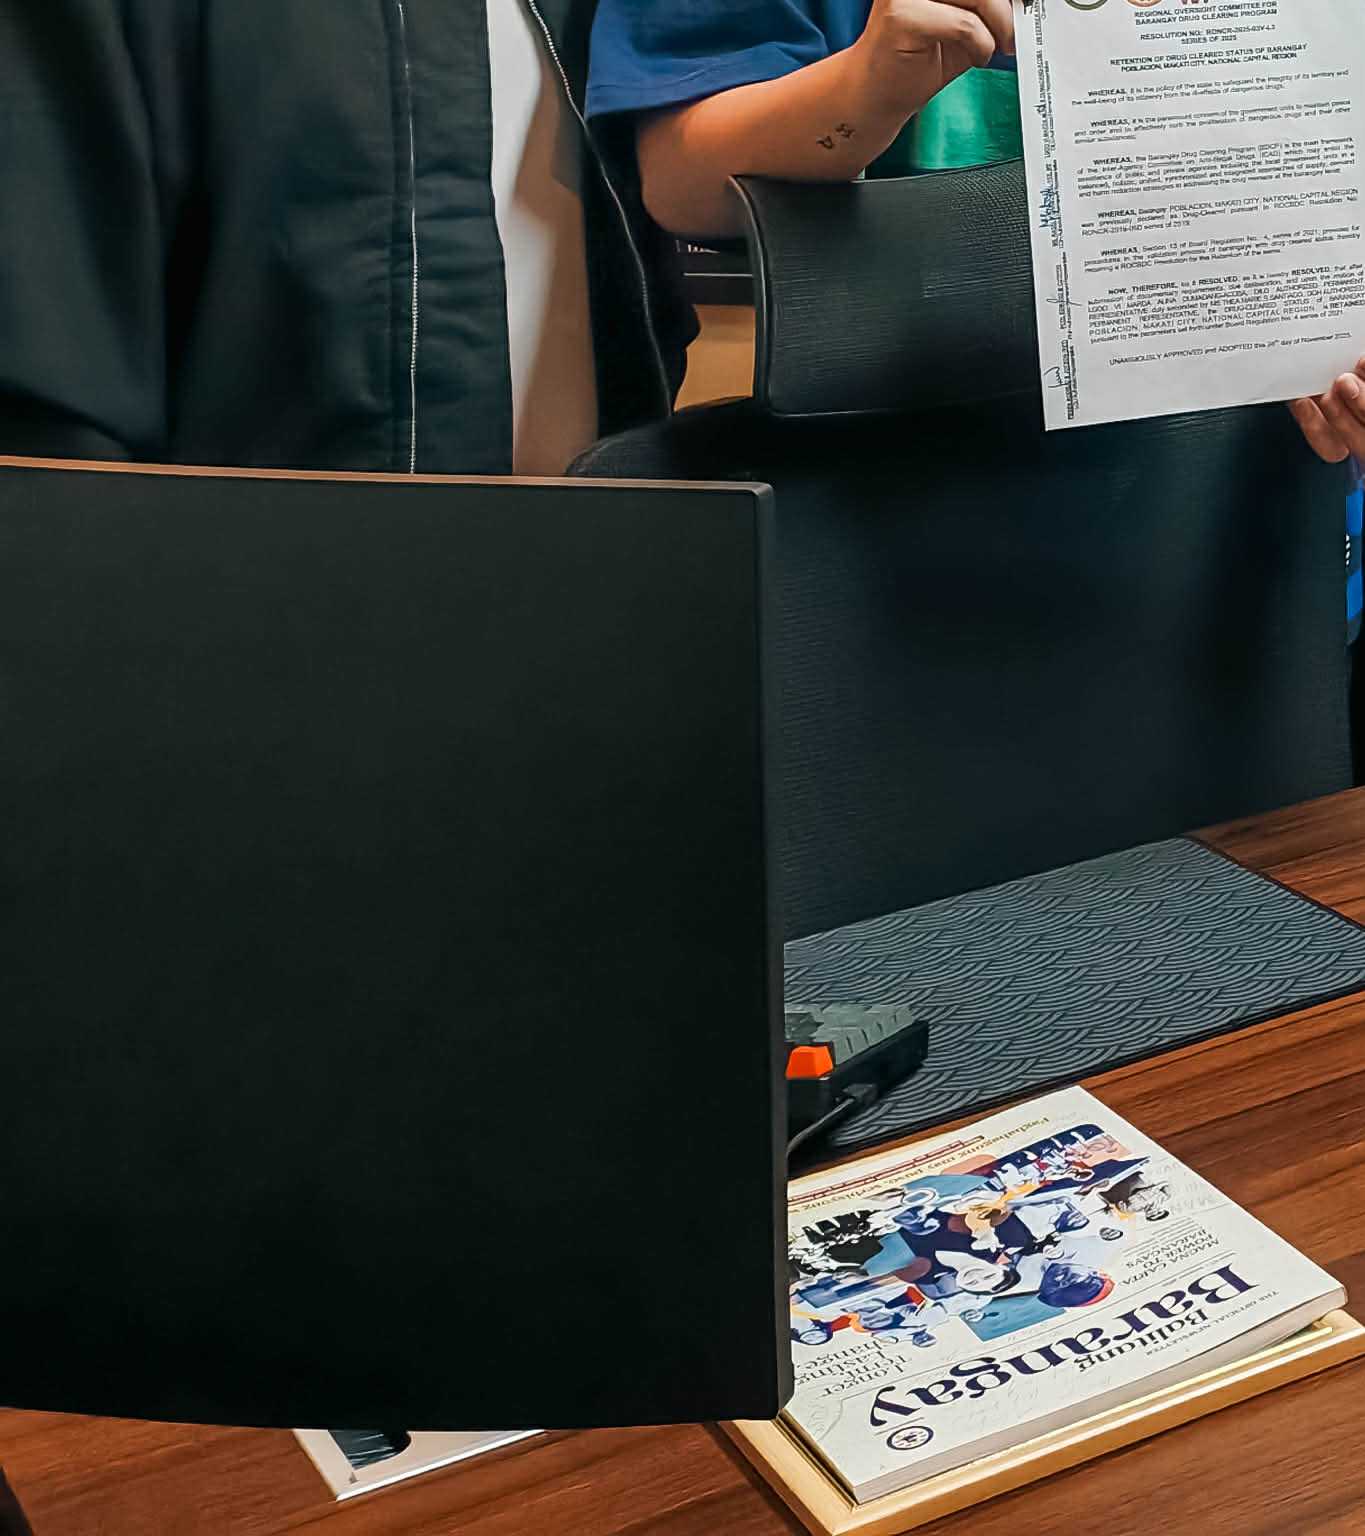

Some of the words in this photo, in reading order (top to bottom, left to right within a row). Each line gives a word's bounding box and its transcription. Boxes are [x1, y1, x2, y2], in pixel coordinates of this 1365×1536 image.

[1261, 0, 1277, 9] FOR
[870, 1262, 1260, 1426] Barangay
[1073, 1309, 1208, 1372] Balitang
